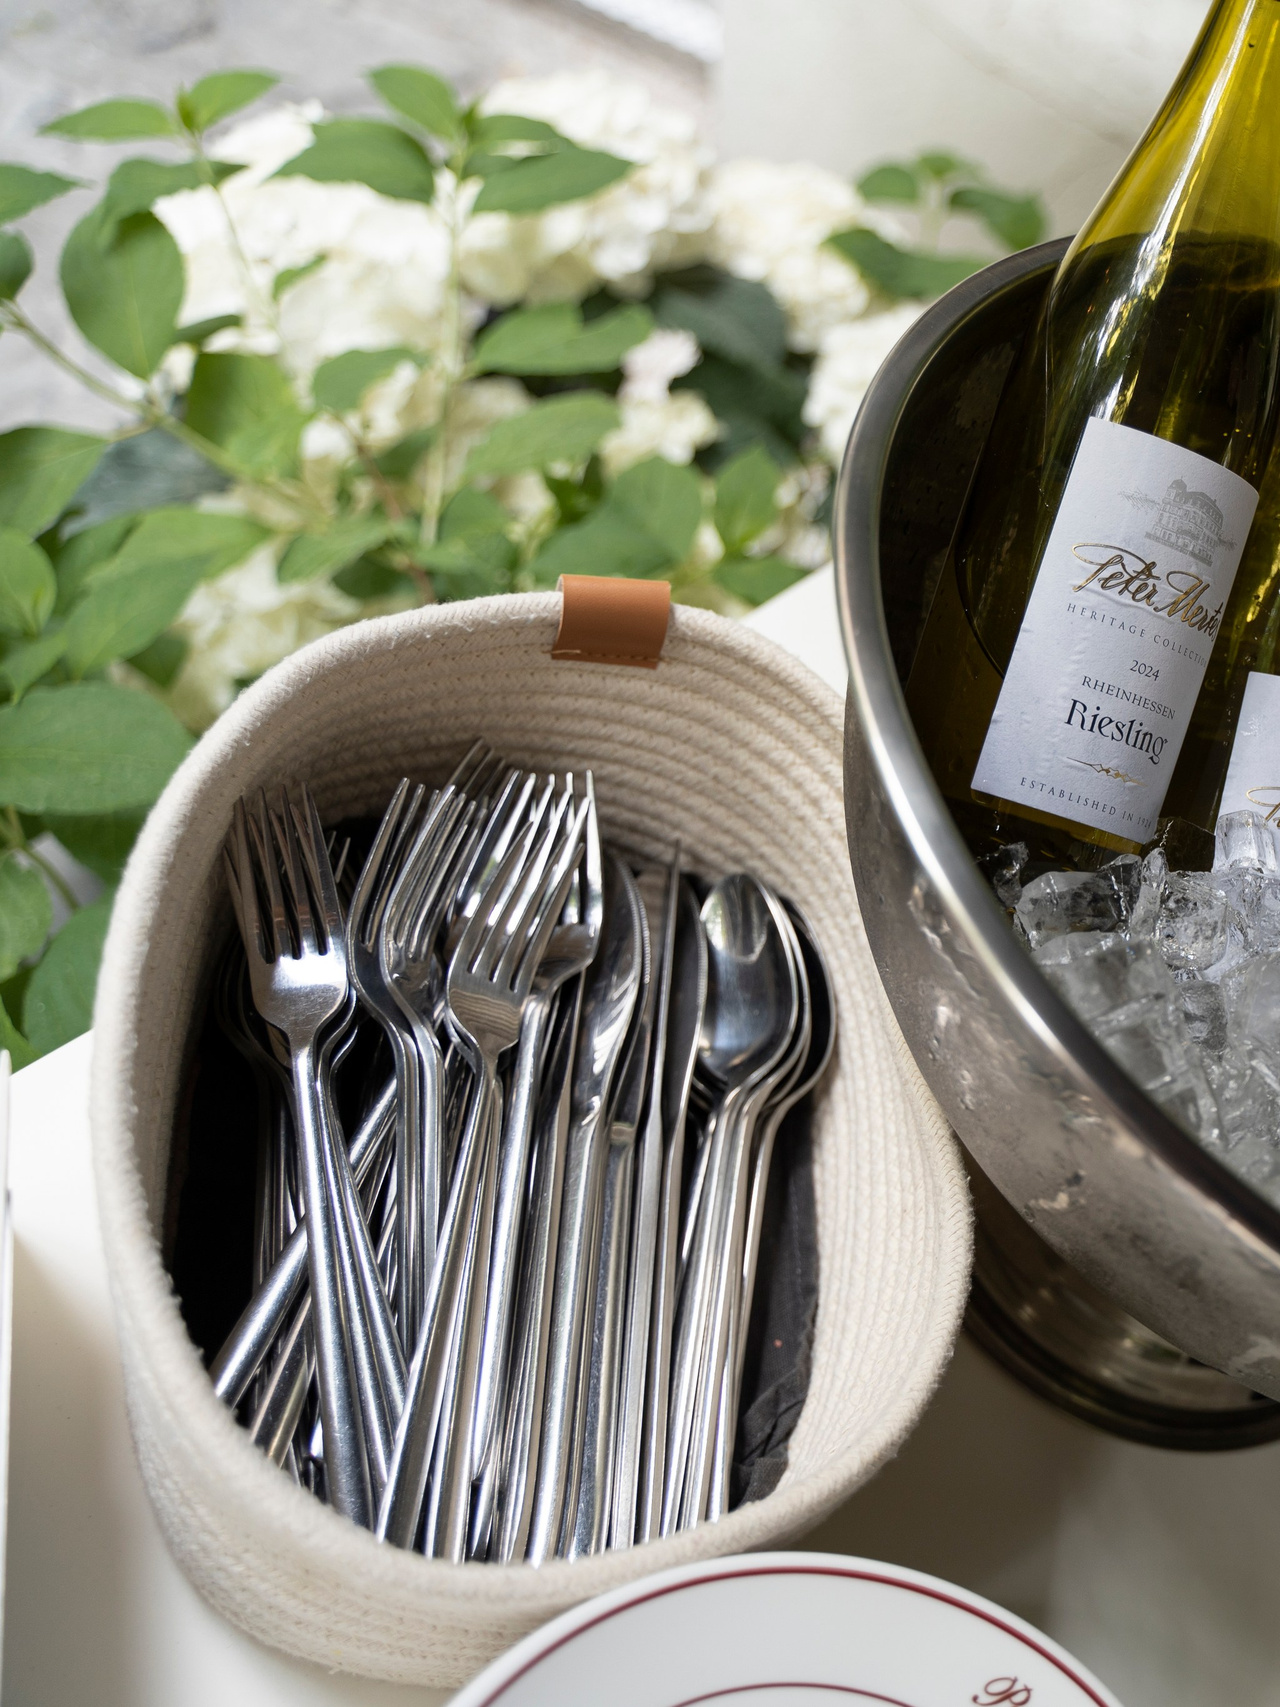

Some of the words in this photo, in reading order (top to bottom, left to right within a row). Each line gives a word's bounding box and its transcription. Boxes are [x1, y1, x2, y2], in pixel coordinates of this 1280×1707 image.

[1072, 543, 1161, 606] Peter
[1067, 603, 1146, 638] HERITAGE
[1130, 660, 1160, 682] 2024
[1082, 675, 1176, 720] RHEINHESSEN
[1064, 698, 1168, 765] Riesling
[1020, 777, 1117, 816] ESTABLISHED
[1122, 811, 1134, 821] IN
